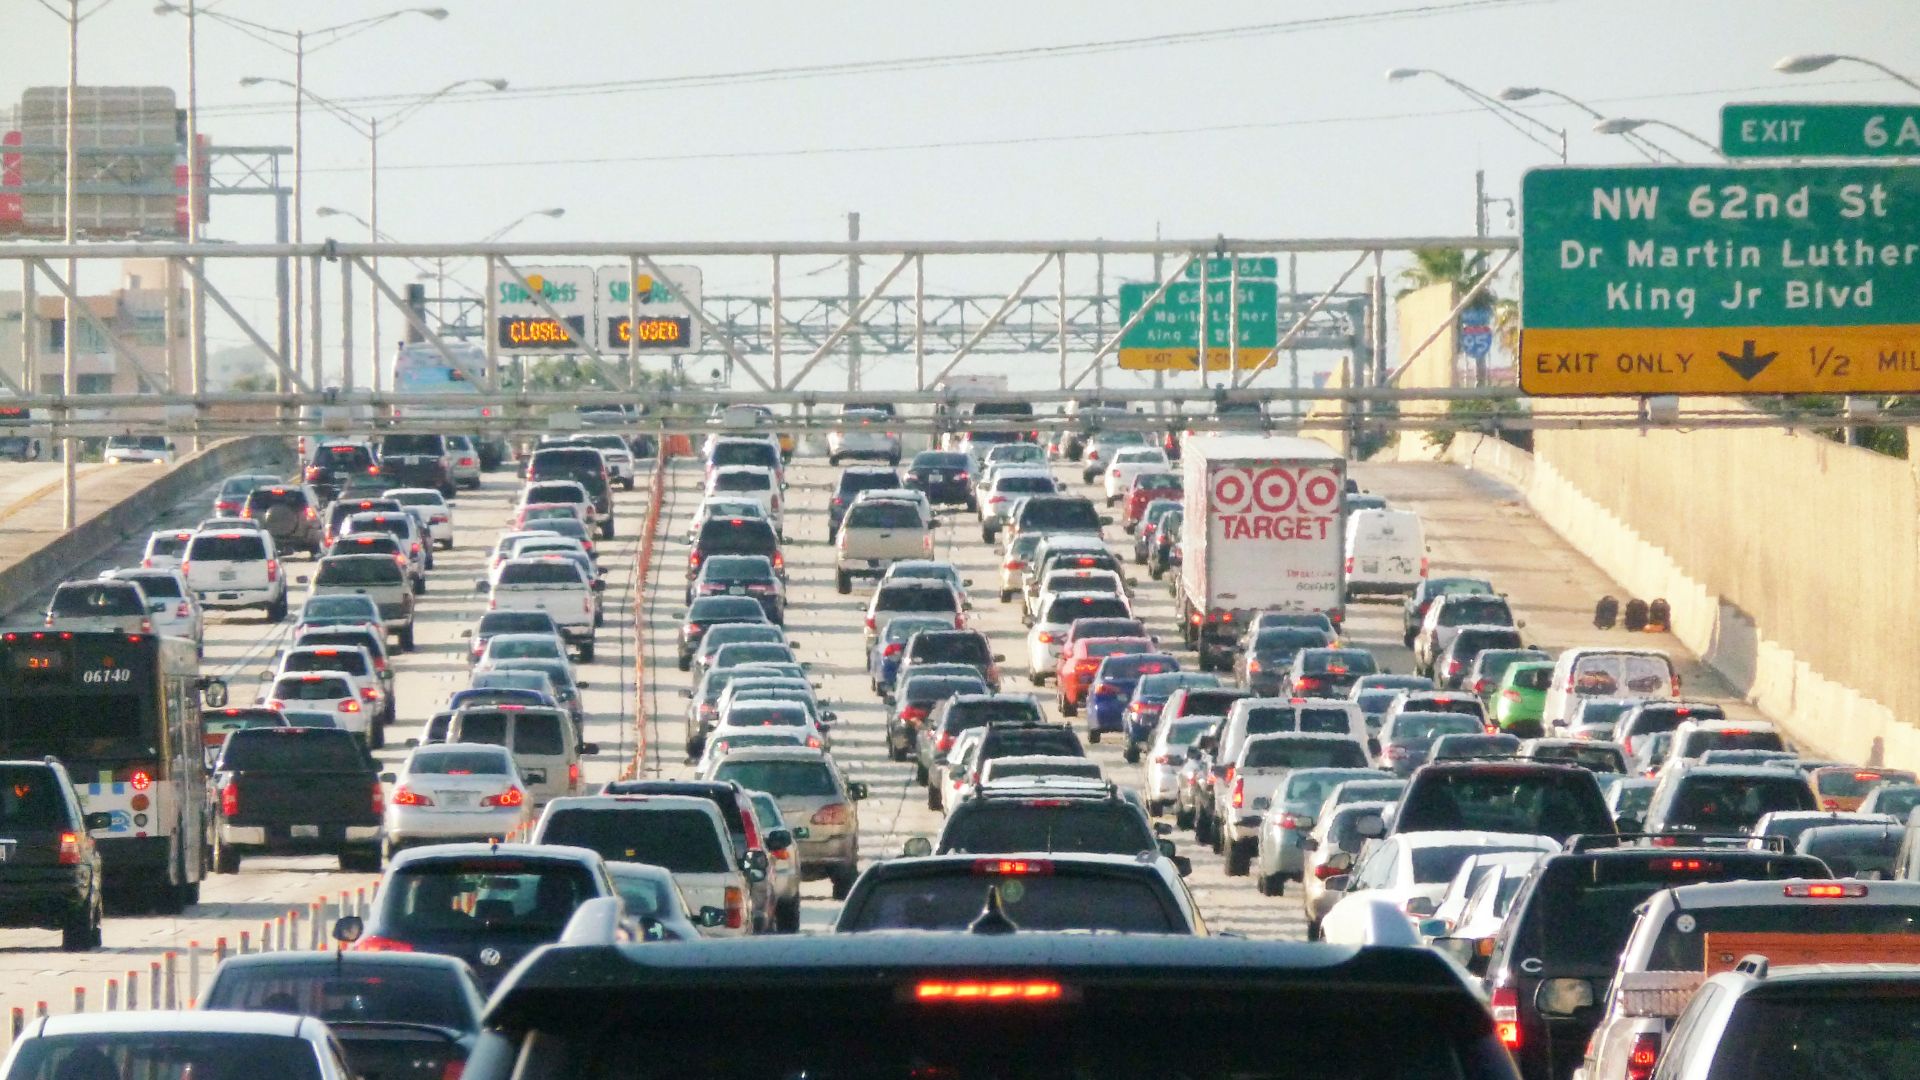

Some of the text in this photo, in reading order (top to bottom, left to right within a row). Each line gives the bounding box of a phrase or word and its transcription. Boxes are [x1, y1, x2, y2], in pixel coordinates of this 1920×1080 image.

[1742, 115, 1920, 147] EXIT 6A
[1593, 184, 1887, 220] NW 62nd St
[1561, 238, 1920, 269] Dr Martin Luther
[1607, 280, 1873, 318] King Jr Blvd
[618, 320, 680, 342] COSED
[1537, 353, 1600, 374] EXIT
[1616, 353, 1695, 374] ONLY
[1809, 346, 1850, 376] 1/2
[1218, 515, 1333, 541] TARGET
